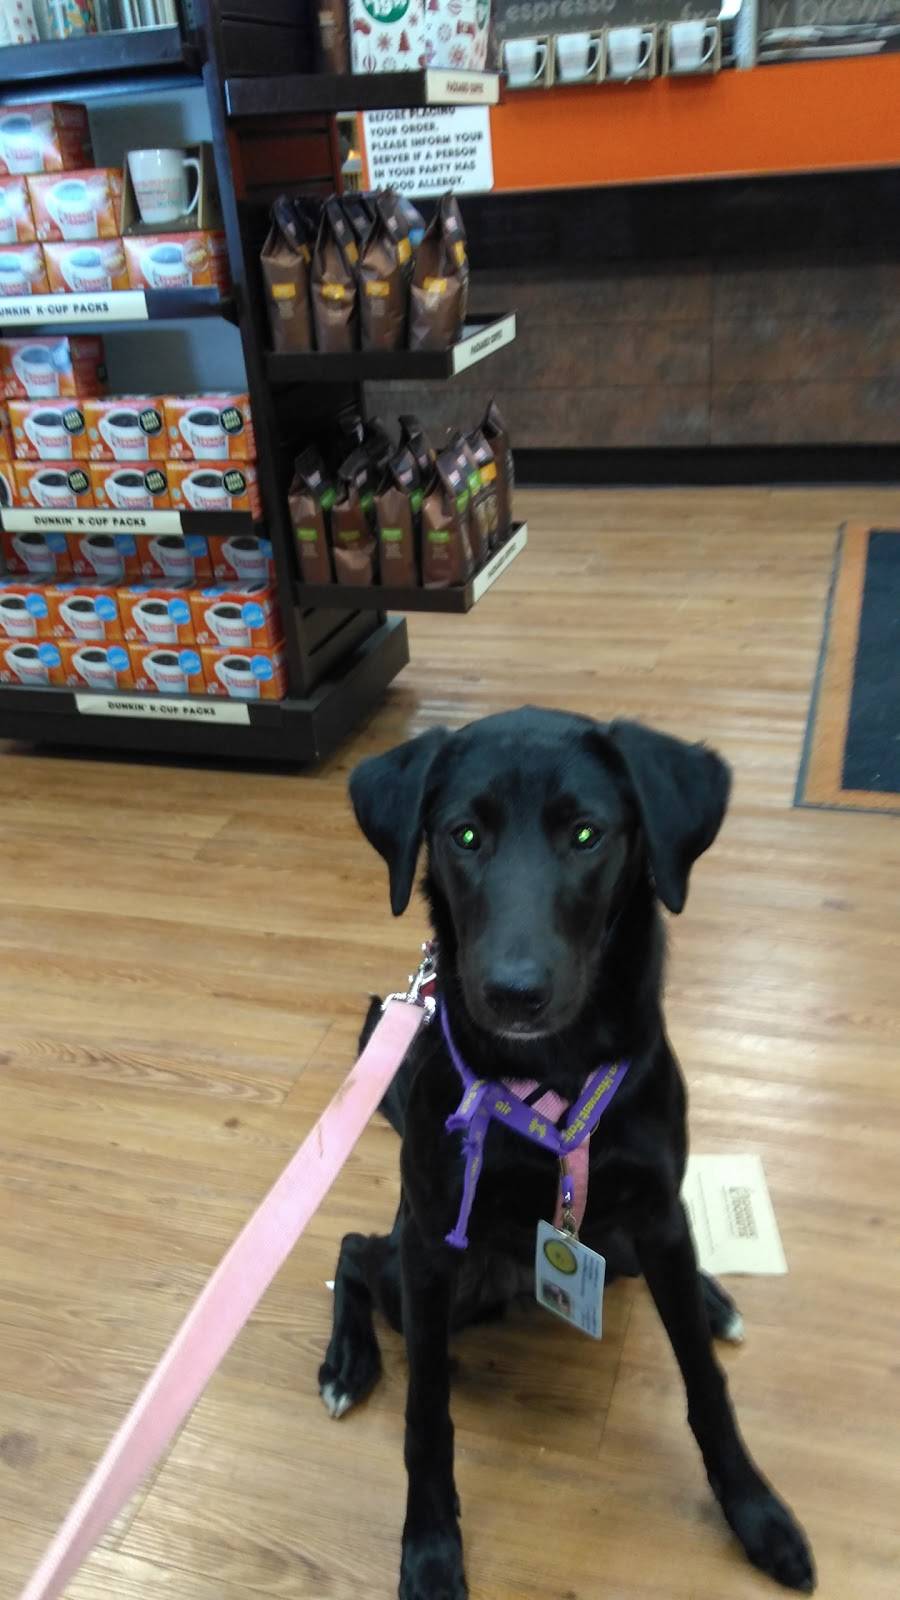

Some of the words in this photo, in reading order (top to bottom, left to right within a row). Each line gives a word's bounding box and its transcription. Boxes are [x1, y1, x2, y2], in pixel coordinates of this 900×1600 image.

[506, 0, 616, 28] espresso
[370, 126, 397, 137] YOUR
[371, 140, 408, 150] PLEASE
[411, 135, 451, 147] INFORM
[454, 131, 484, 142] YOUR
[373, 153, 410, 165] SERVER
[425, 151, 433, 160] A
[436, 147, 478, 159] PERSON
[374, 168, 385, 179] IN
[388, 166, 416, 177] YOUR
[419, 163, 452, 174] PARTY
[455, 160, 476, 171] HAS
[73, 301, 110, 313] PACKS
[112, 517, 147, 527] PACKS
[182, 706, 216, 716] PACKS
